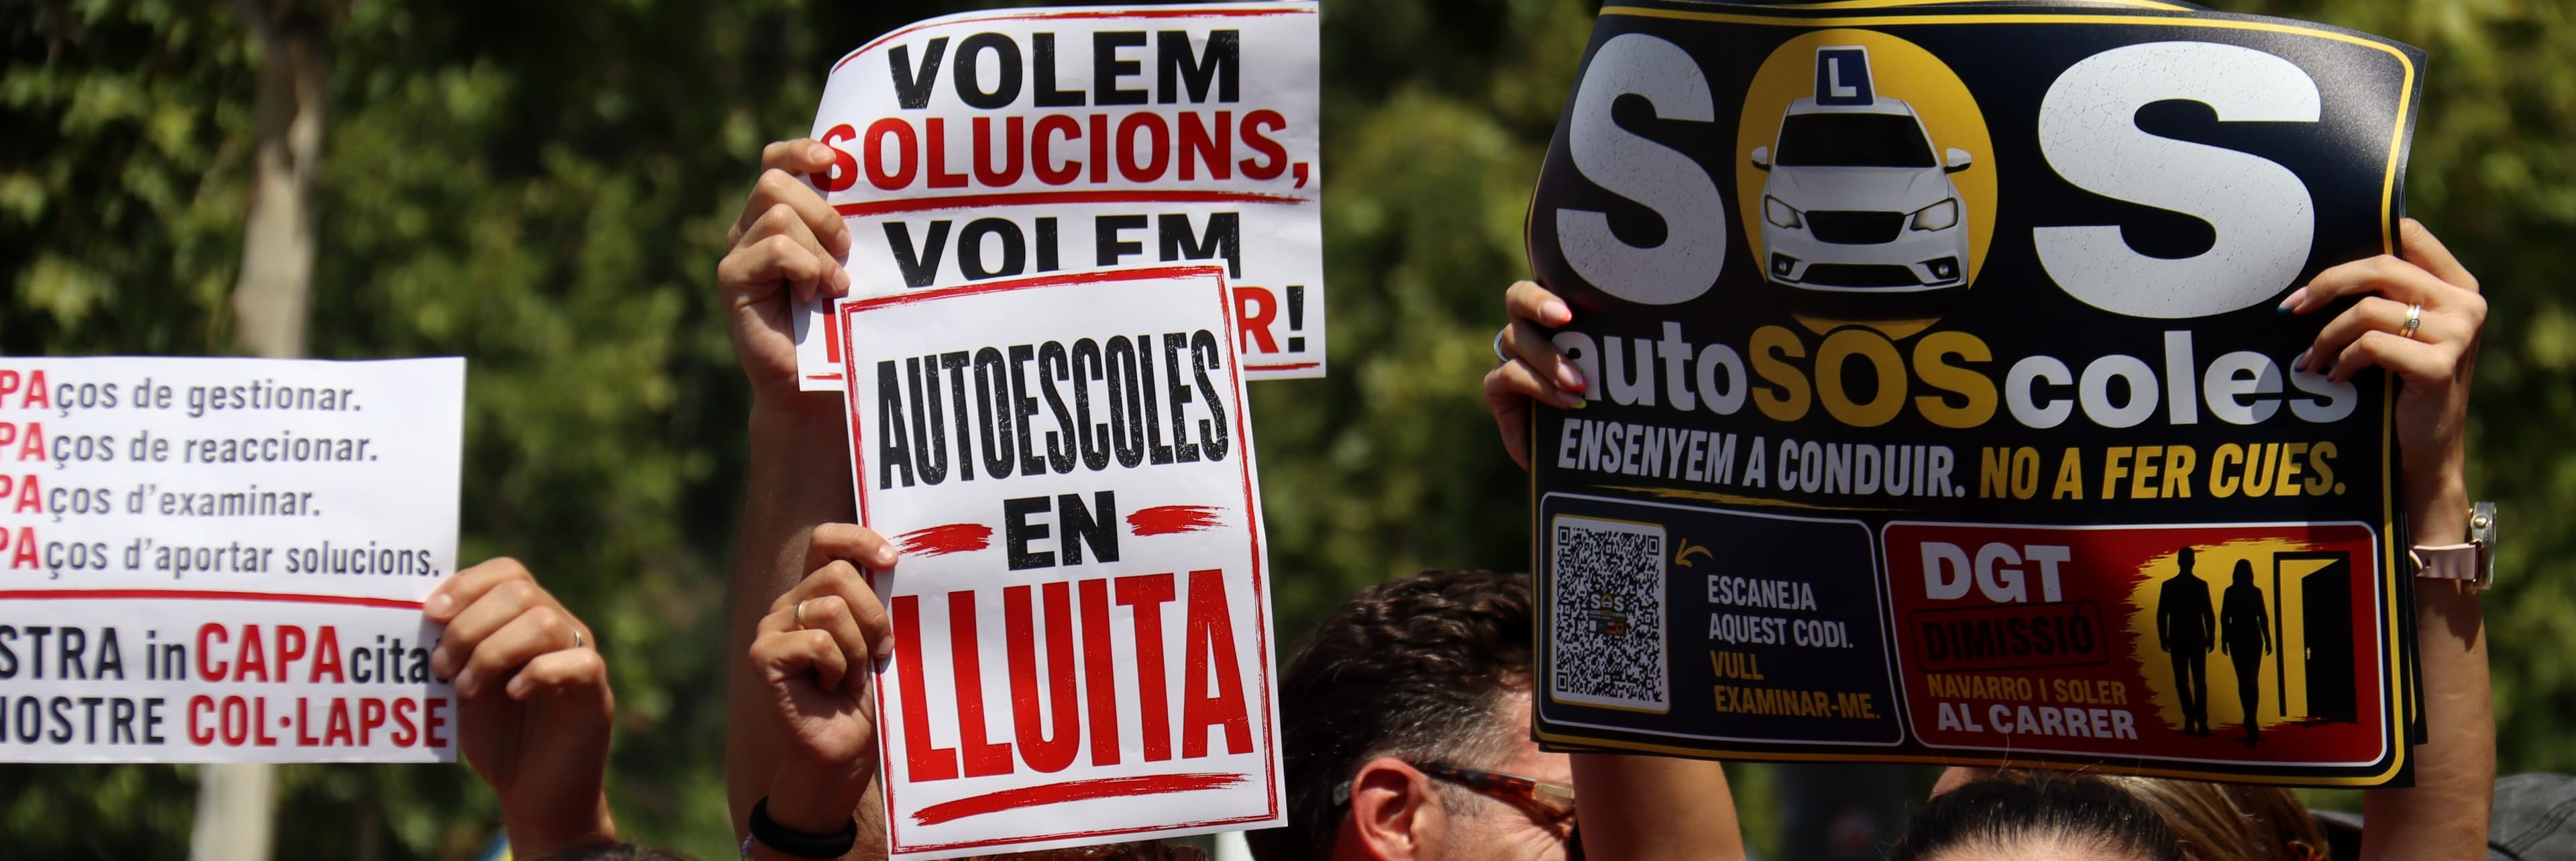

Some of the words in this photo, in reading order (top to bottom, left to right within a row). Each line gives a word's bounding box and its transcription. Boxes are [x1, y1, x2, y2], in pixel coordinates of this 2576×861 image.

[888, 30, 1240, 109] VOLEM
[1828, 58, 1857, 97] L
[810, 109, 1309, 191] SOLUCIONS,
[882, 212, 1242, 288] VOLEM
[132, 378, 172, 409] de
[186, 380, 362, 417] gestionar.
[1551, 321, 2357, 429] autoSOScoles
[876, 329, 1228, 490] AUTOESCOLES
[129, 430, 169, 462] de
[183, 432, 377, 463] reaccionar.
[1558, 418, 1737, 486] ENSENYEM
[1742, 436, 1766, 489] A
[1777, 439, 1966, 498] CONDUIR.
[1980, 446, 2041, 499] NO
[2052, 445, 2084, 501] A
[2101, 445, 2197, 499] FER
[2208, 440, 2347, 499] CUES.
[1003, 491, 1120, 572] EN
[285, 542, 440, 578] solucions.
[1920, 541, 2072, 603] DGT
[1707, 574, 1817, 611] ESCANEJA
[145, 623, 450, 685] inCAPAcita
[1709, 613, 1787, 646] AQUEST
[1793, 618, 1854, 649] CODI.
[1925, 607, 2094, 662] DIMISSIÓ
[891, 568, 1254, 783] LLUITA
[1710, 650, 1765, 681] VULL
[1927, 673, 2033, 702] NAVARRO
[2040, 680, 2047, 703] I
[2053, 678, 2128, 705] SOLER
[0, 695, 166, 745] OSTRE
[1714, 685, 1881, 719] EXAMINAR-ME.
[1937, 702, 1984, 733] AL
[1988, 705, 2138, 740] CARRER
